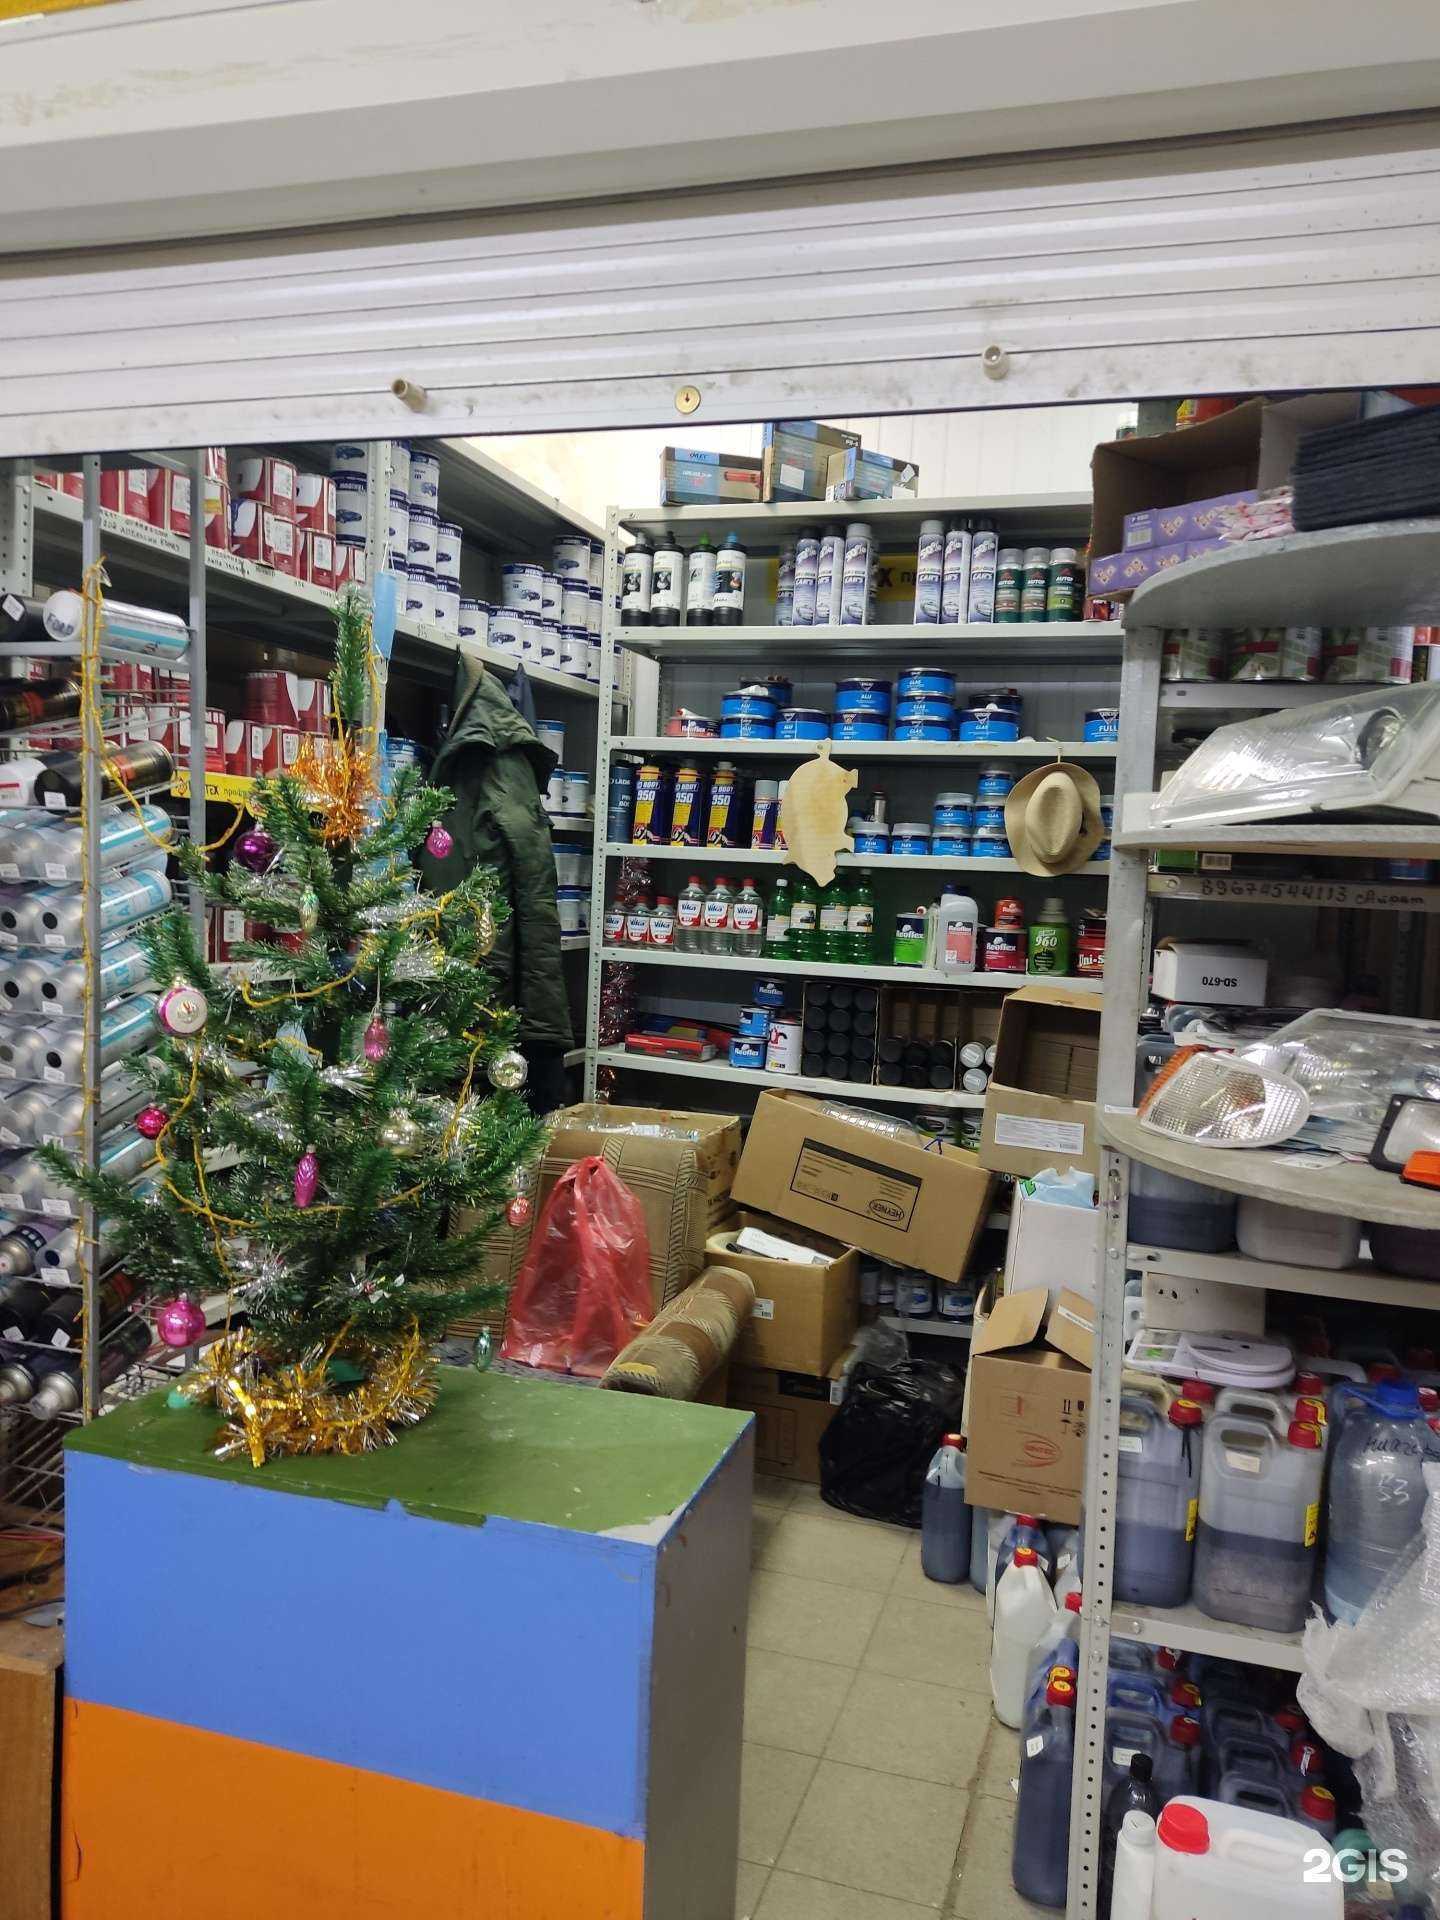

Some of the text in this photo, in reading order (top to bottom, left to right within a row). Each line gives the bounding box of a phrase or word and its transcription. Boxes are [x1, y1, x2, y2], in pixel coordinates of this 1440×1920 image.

[637, 790, 656, 801] 950
[675, 792, 694, 803] 950
[712, 794, 731, 806] 950
[654, 920, 670, 930] Vika
[1035, 935, 1058, 947] 960
[1201, 976, 1238, 988] SD-670
